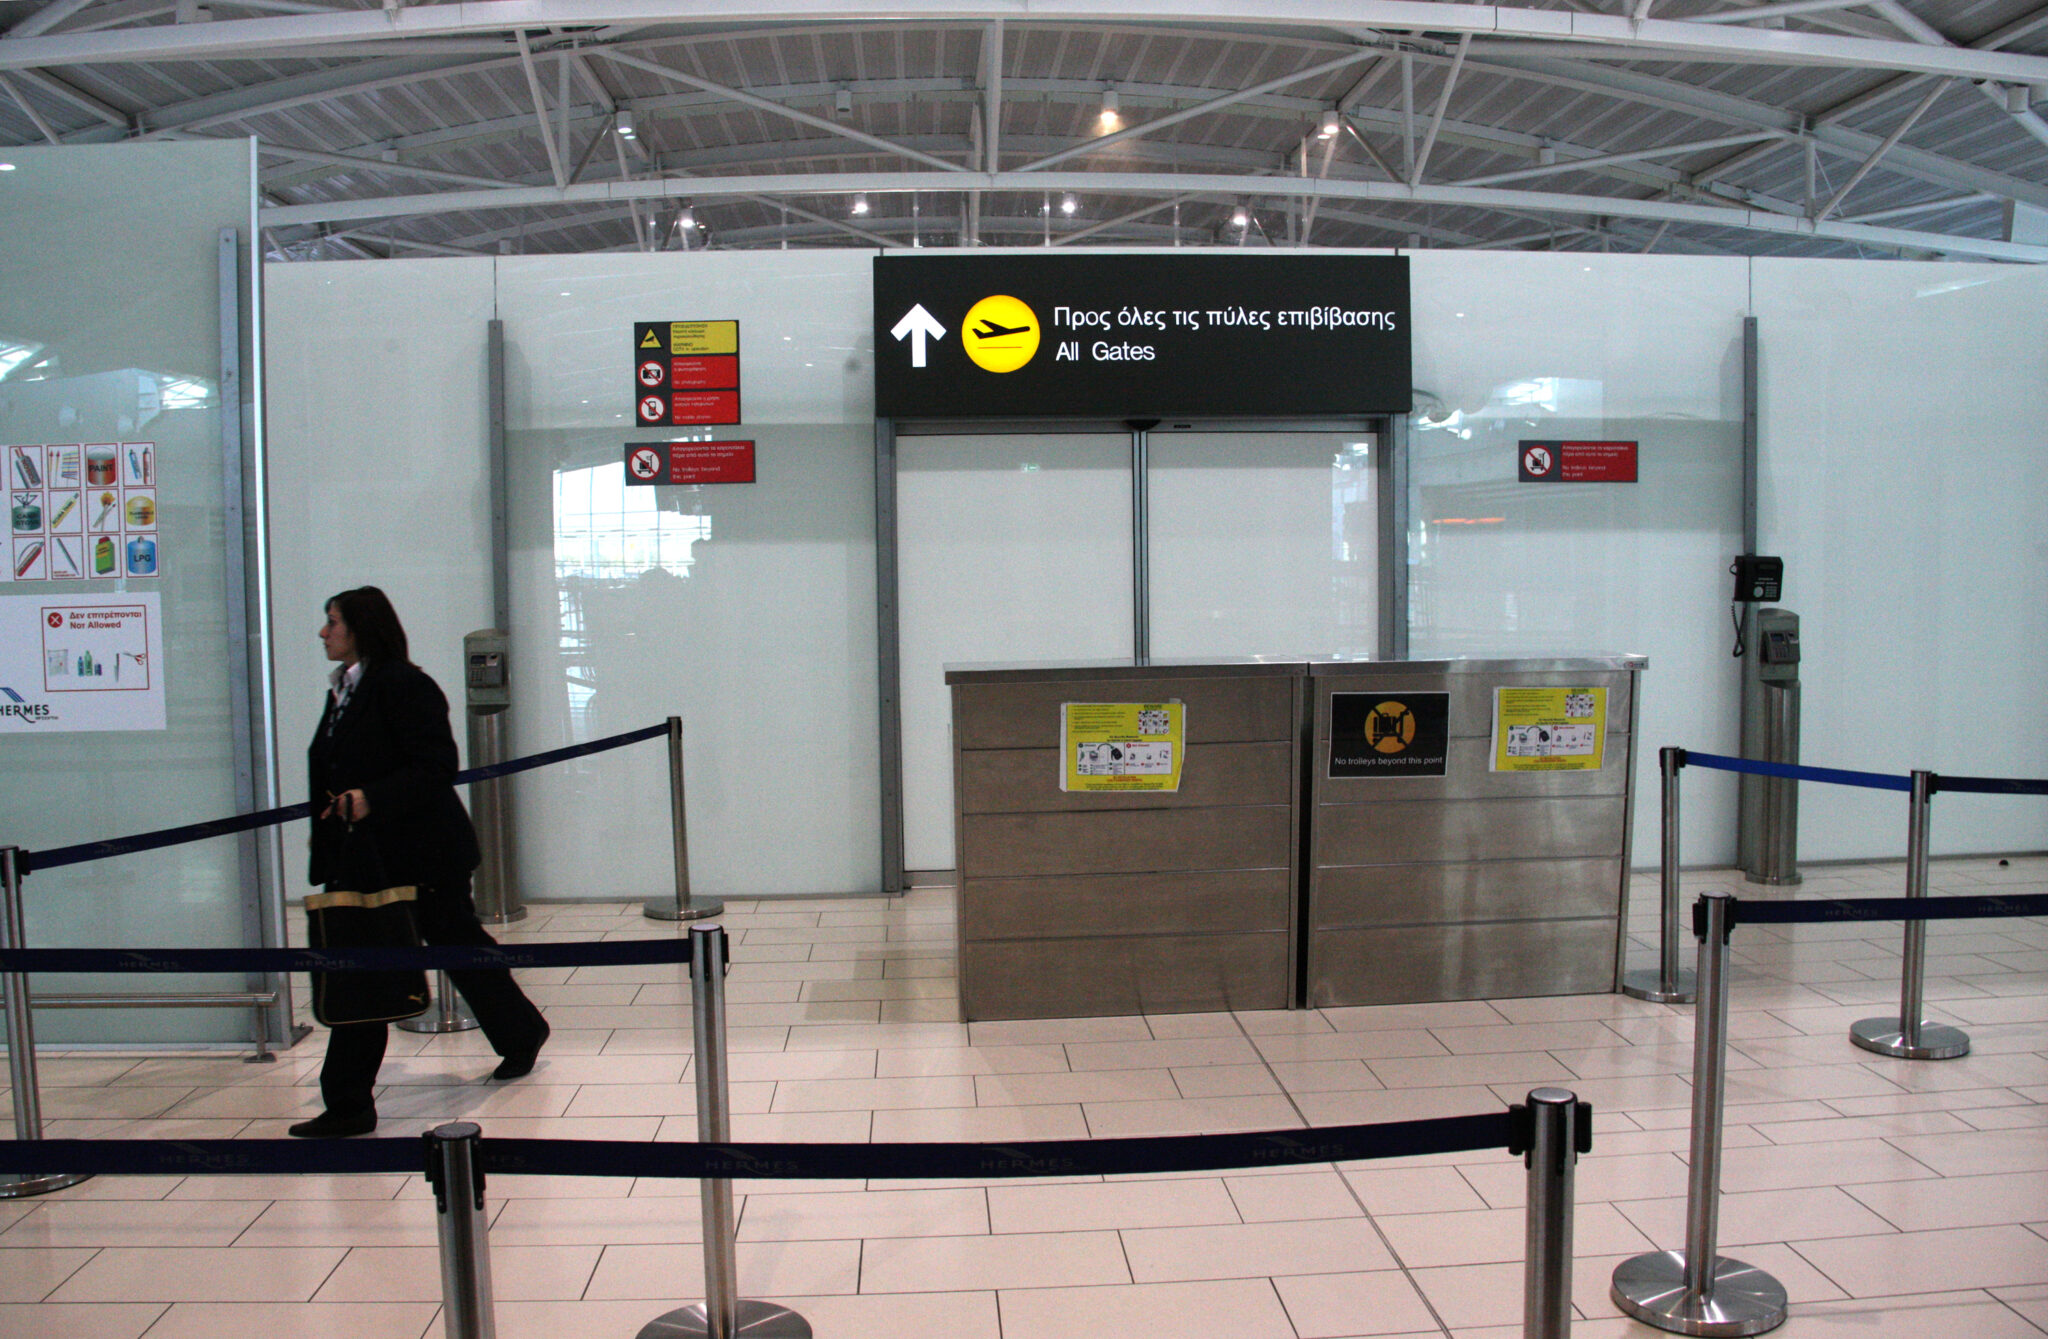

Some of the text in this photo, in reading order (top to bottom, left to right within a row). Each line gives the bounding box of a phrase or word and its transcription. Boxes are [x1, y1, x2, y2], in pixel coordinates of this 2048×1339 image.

[1053, 306, 1396, 330] Προς όλες τις πύλες επιβίβασης
[1055, 341, 1156, 361] All Gates
[88, 463, 114, 473] PAINT
[133, 554, 152, 563] LPG
[69, 610, 142, 620] Δεν επιτρέπονται
[70, 621, 122, 630] Not Allowed
[1334, 756, 1443, 767] No trolleys beyond this point
[1254, 1144, 1345, 1159] HERMES
[705, 1160, 798, 1171] HERMES
[980, 1158, 1074, 1169] HERMES
